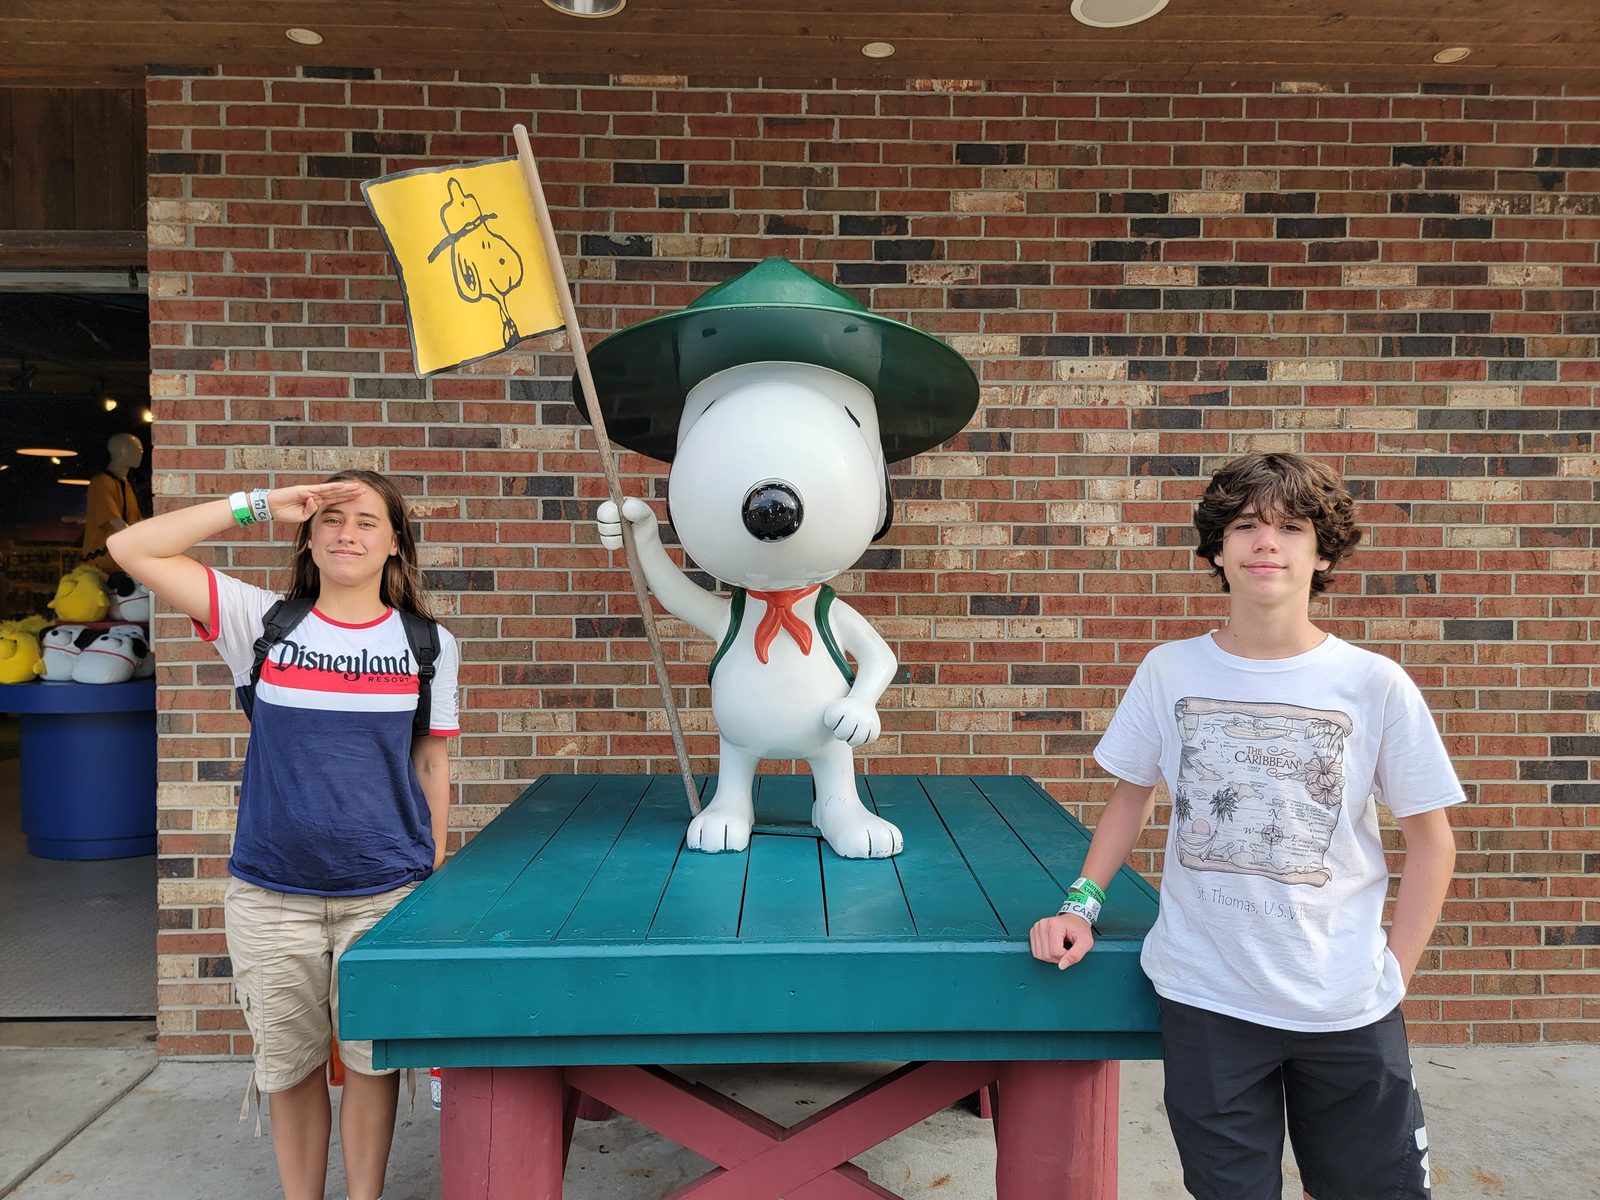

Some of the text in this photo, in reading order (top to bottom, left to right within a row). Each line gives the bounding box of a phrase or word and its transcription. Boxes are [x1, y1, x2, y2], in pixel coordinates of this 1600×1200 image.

[270, 640, 412, 682] Disneyland
[368, 676, 410, 684] RESORT
[1246, 746, 1263, 755] THE
[1234, 751, 1300, 770] CARIBBEAN
[1268, 808, 1282, 820] N
[1242, 826, 1255, 834] W
[1290, 834, 1299, 842] E
[1266, 852, 1274, 860] S
[1197, 885, 1207, 901] St.
[1211, 887, 1259, 914] Thomas,
